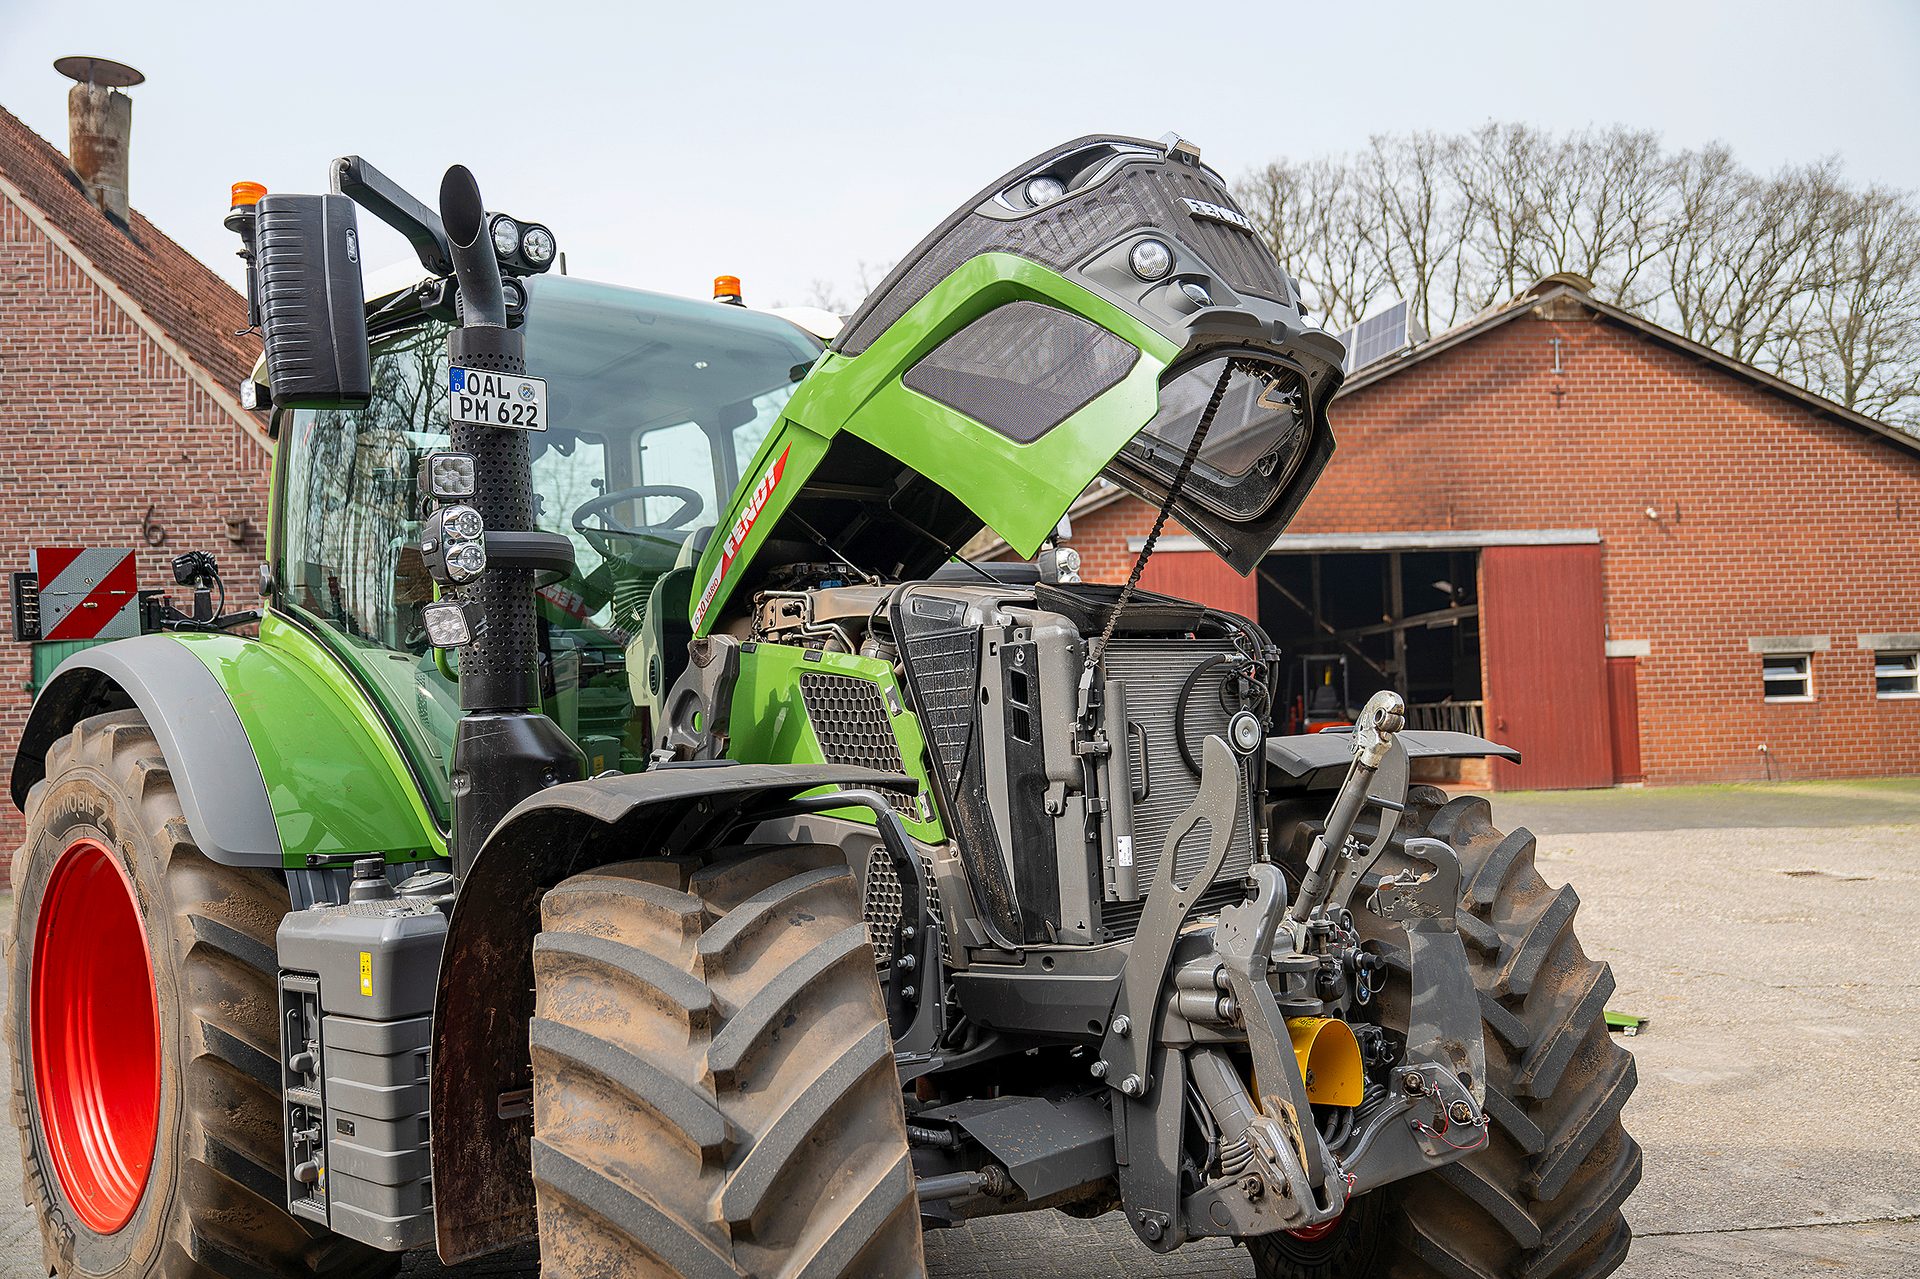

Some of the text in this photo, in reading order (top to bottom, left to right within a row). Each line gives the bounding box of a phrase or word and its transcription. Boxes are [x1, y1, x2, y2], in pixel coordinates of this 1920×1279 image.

[467, 372, 511, 400] OAL
[459, 396, 539, 428] PM 622
[723, 457, 777, 560] FENDT
[694, 577, 719, 626] 620 VARIO
